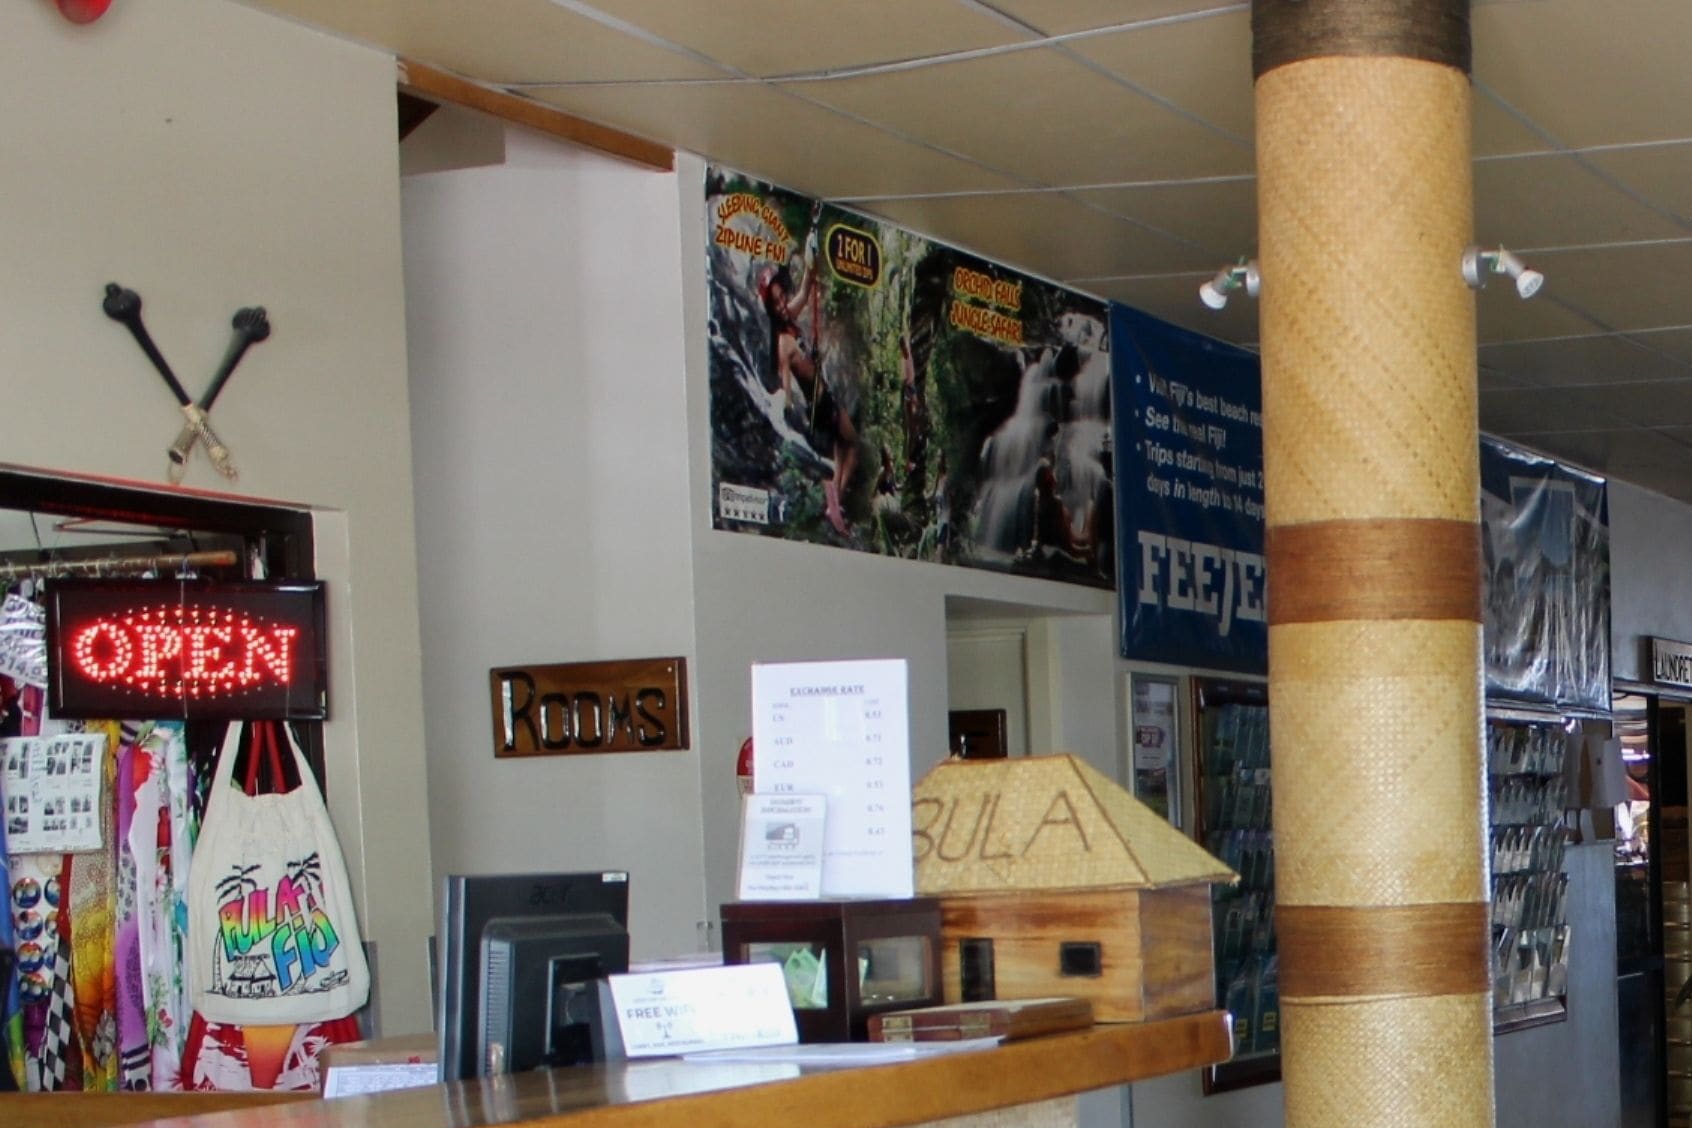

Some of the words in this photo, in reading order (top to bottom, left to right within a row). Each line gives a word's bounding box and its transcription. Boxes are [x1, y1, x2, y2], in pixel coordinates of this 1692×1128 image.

[716, 193, 760, 224] SLEEPING
[761, 206, 789, 242] GIANT
[715, 224, 762, 256] ZIPLINE
[765, 241, 786, 263] FIJI
[844, 235, 865, 265] FOR
[954, 266, 993, 300] ORCHID
[994, 280, 1022, 312] FALLS
[951, 300, 990, 336] JUNGLE
[990, 312, 1023, 346] SAFARI
[1169, 381, 1194, 408] Fiji's
[1196, 389, 1218, 414] best
[1220, 396, 1249, 423] beach
[1145, 405, 1170, 431] See
[1208, 425, 1227, 451] Fiji!
[1144, 439, 1174, 468] Trips
[1176, 448, 1214, 480] starting
[1215, 459, 1237, 483] from
[1238, 465, 1256, 489] just
[1146, 471, 1170, 499] days
[1173, 477, 1186, 499] in
[1187, 481, 1221, 509] length
[1137, 530, 1268, 637] FEEJE
[74, 620, 297, 684] OPEN
[789, 686, 838, 698] EXCHANGE
[840, 684, 865, 696] RATE
[912, 789, 1093, 864] BULA
[626, 1006, 662, 1020] FREE
